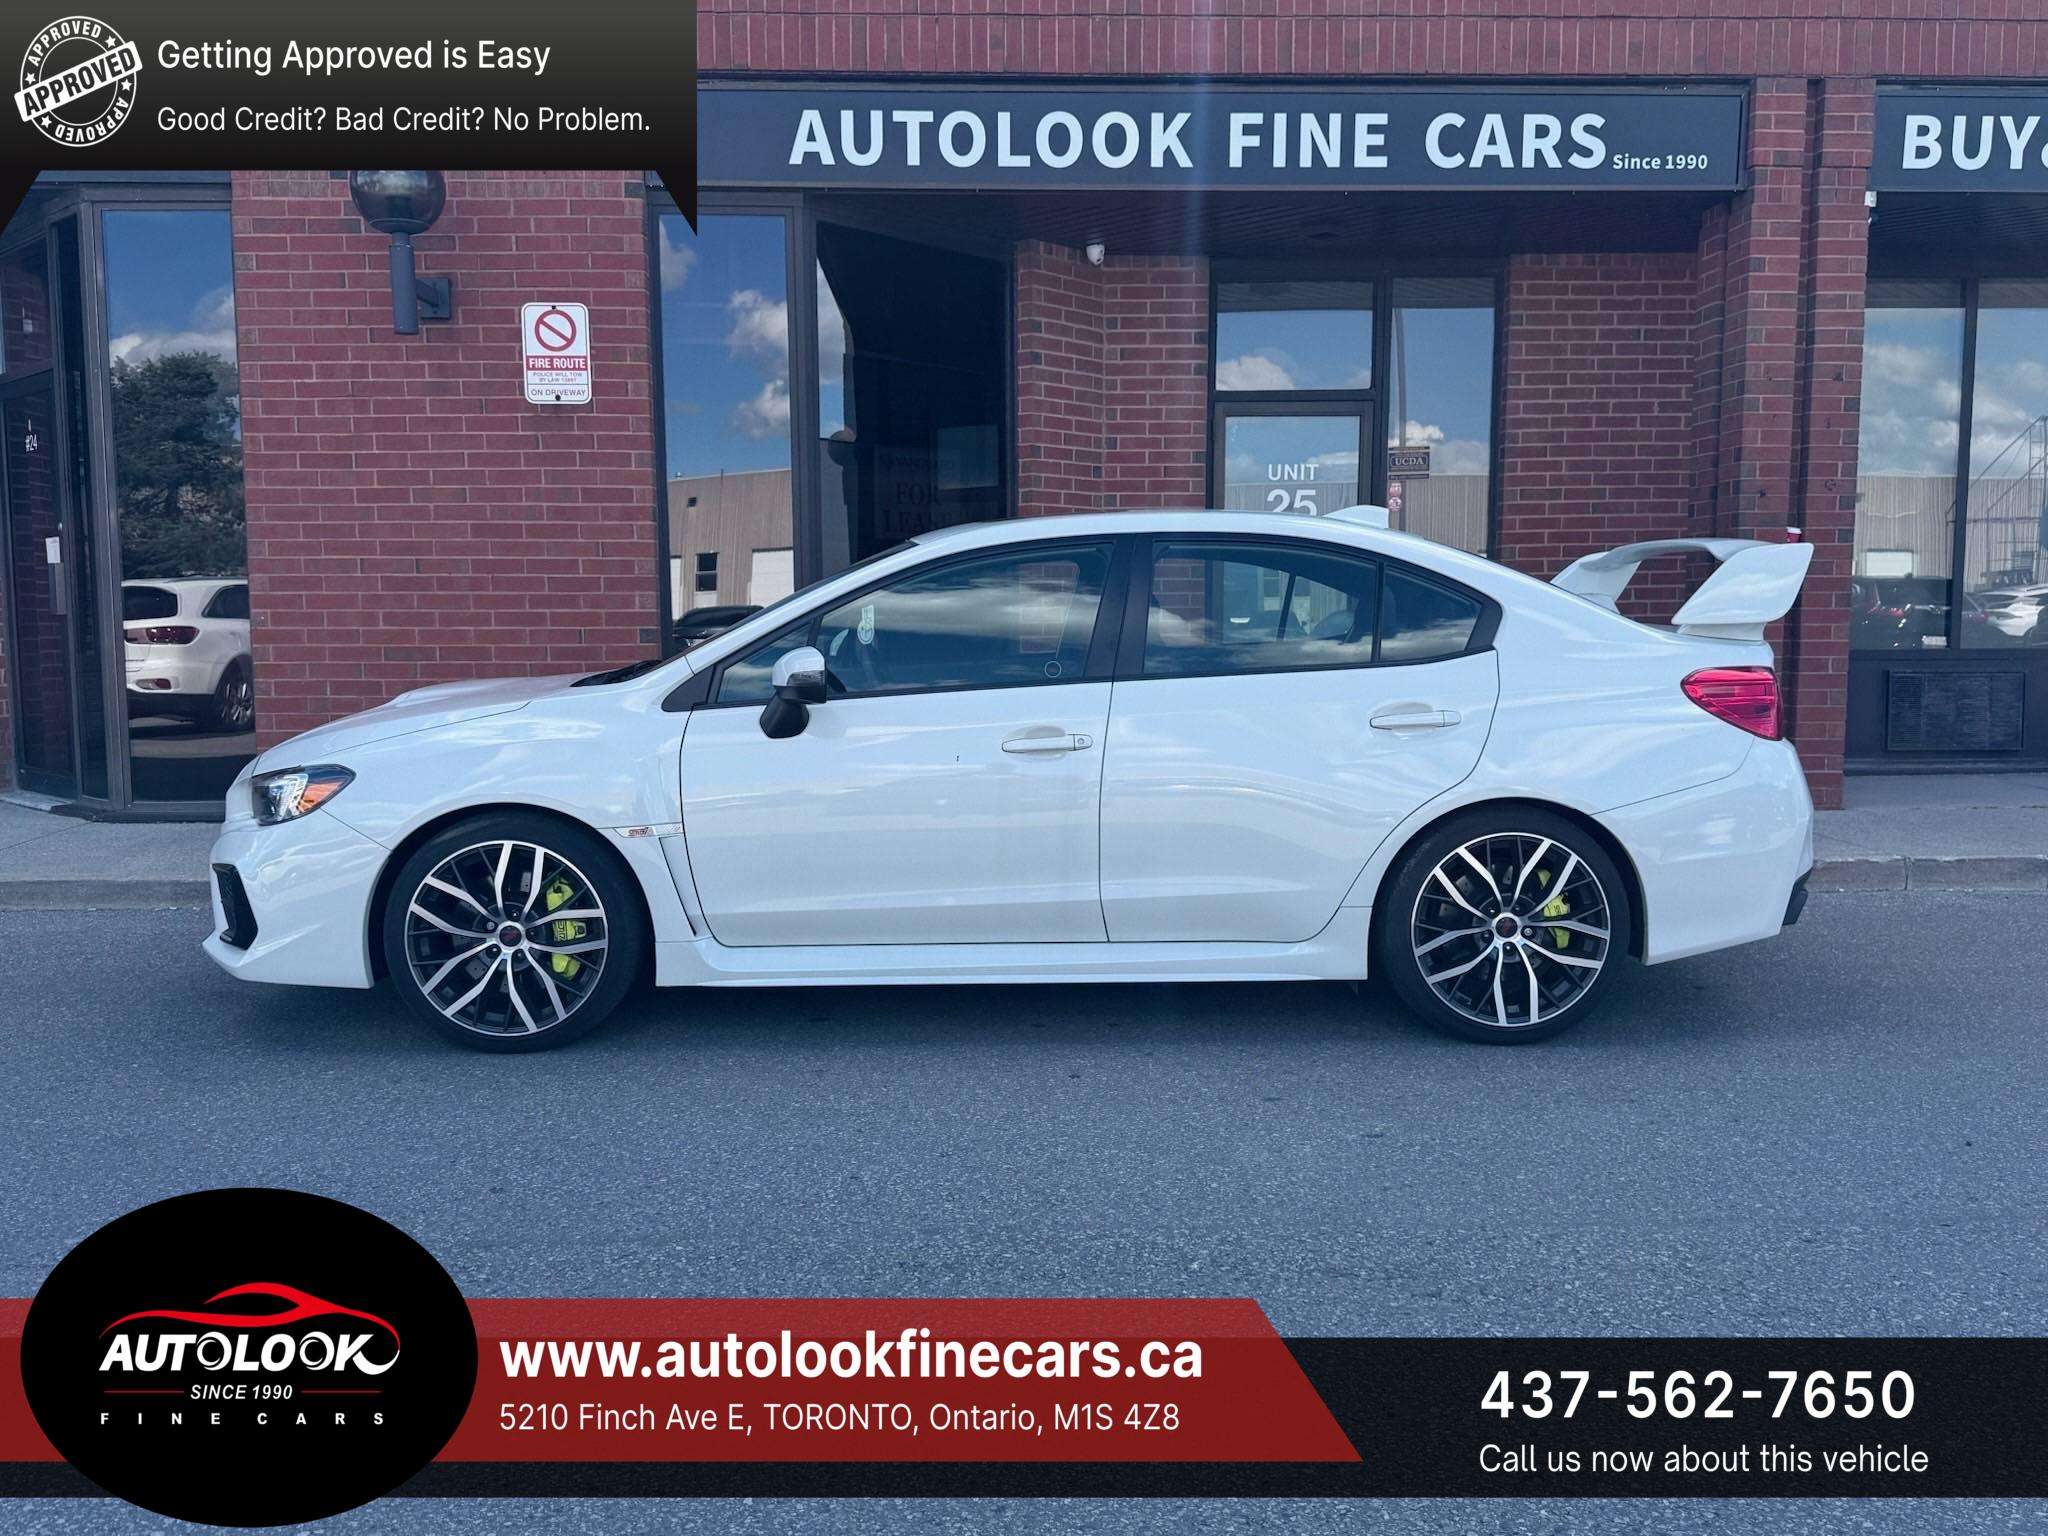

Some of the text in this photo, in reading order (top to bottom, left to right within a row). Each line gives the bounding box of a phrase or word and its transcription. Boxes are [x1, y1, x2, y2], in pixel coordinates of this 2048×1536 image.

[789, 108, 1607, 170] AUTOLOOK FINE CARS
[1902, 114, 2048, 171] BUY
[1612, 153, 1708, 170] Since 1990
[529, 358, 586, 369] FIRE ROUTE
[25, 434, 38, 453] #24
[1395, 457, 1424, 466] UCDA
[1268, 463, 1319, 481] UNIT
[1266, 488, 1318, 517] 25
